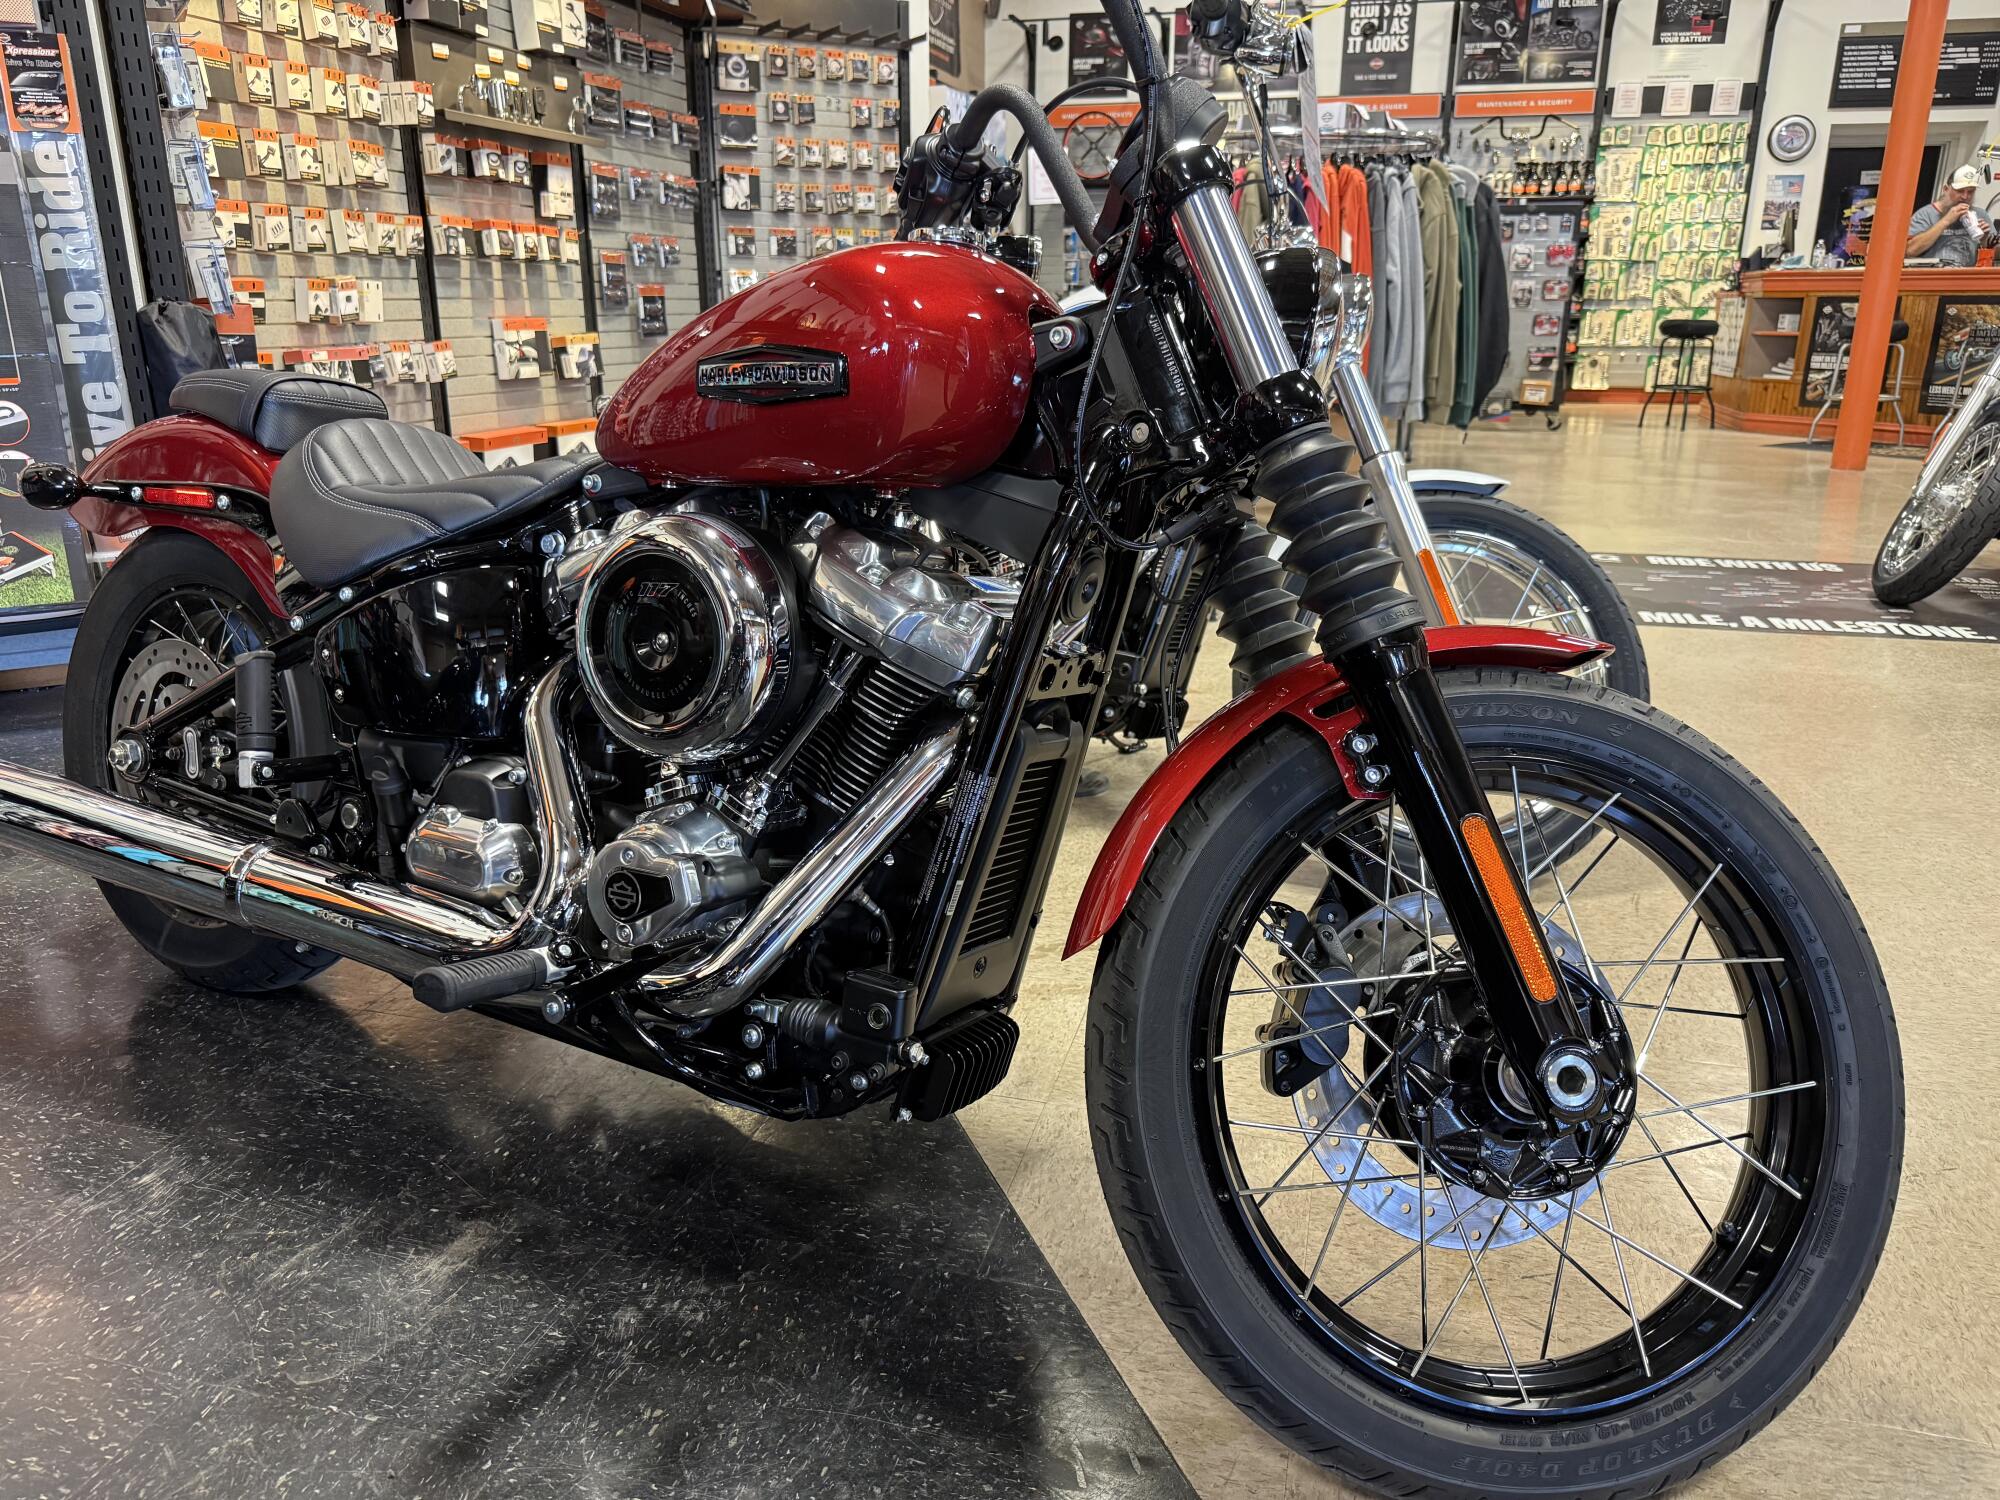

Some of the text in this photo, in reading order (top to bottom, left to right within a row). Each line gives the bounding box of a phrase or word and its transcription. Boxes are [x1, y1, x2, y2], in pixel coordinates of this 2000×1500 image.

[1390, 17, 1410, 34] AS
[1346, 35, 1410, 54] IT LOOKS
[1680, 35, 1712, 43] BATTERY
[5, 45, 56, 57] Xpressionz
[1537, 98, 1573, 106] SECURITY
[27, 140, 96, 271] Ride
[56, 290, 112, 364] To
[701, 364, 833, 385] HARLEY-DAVIDSON
[1646, 556, 1844, 573] RIDE WITH US
[638, 582, 680, 597] 117
[677, 589, 698, 618] INCHES
[1637, 610, 1998, 641] MILE, A MILESTONE.
[1578, 1409, 1717, 1477] DUNLOP
